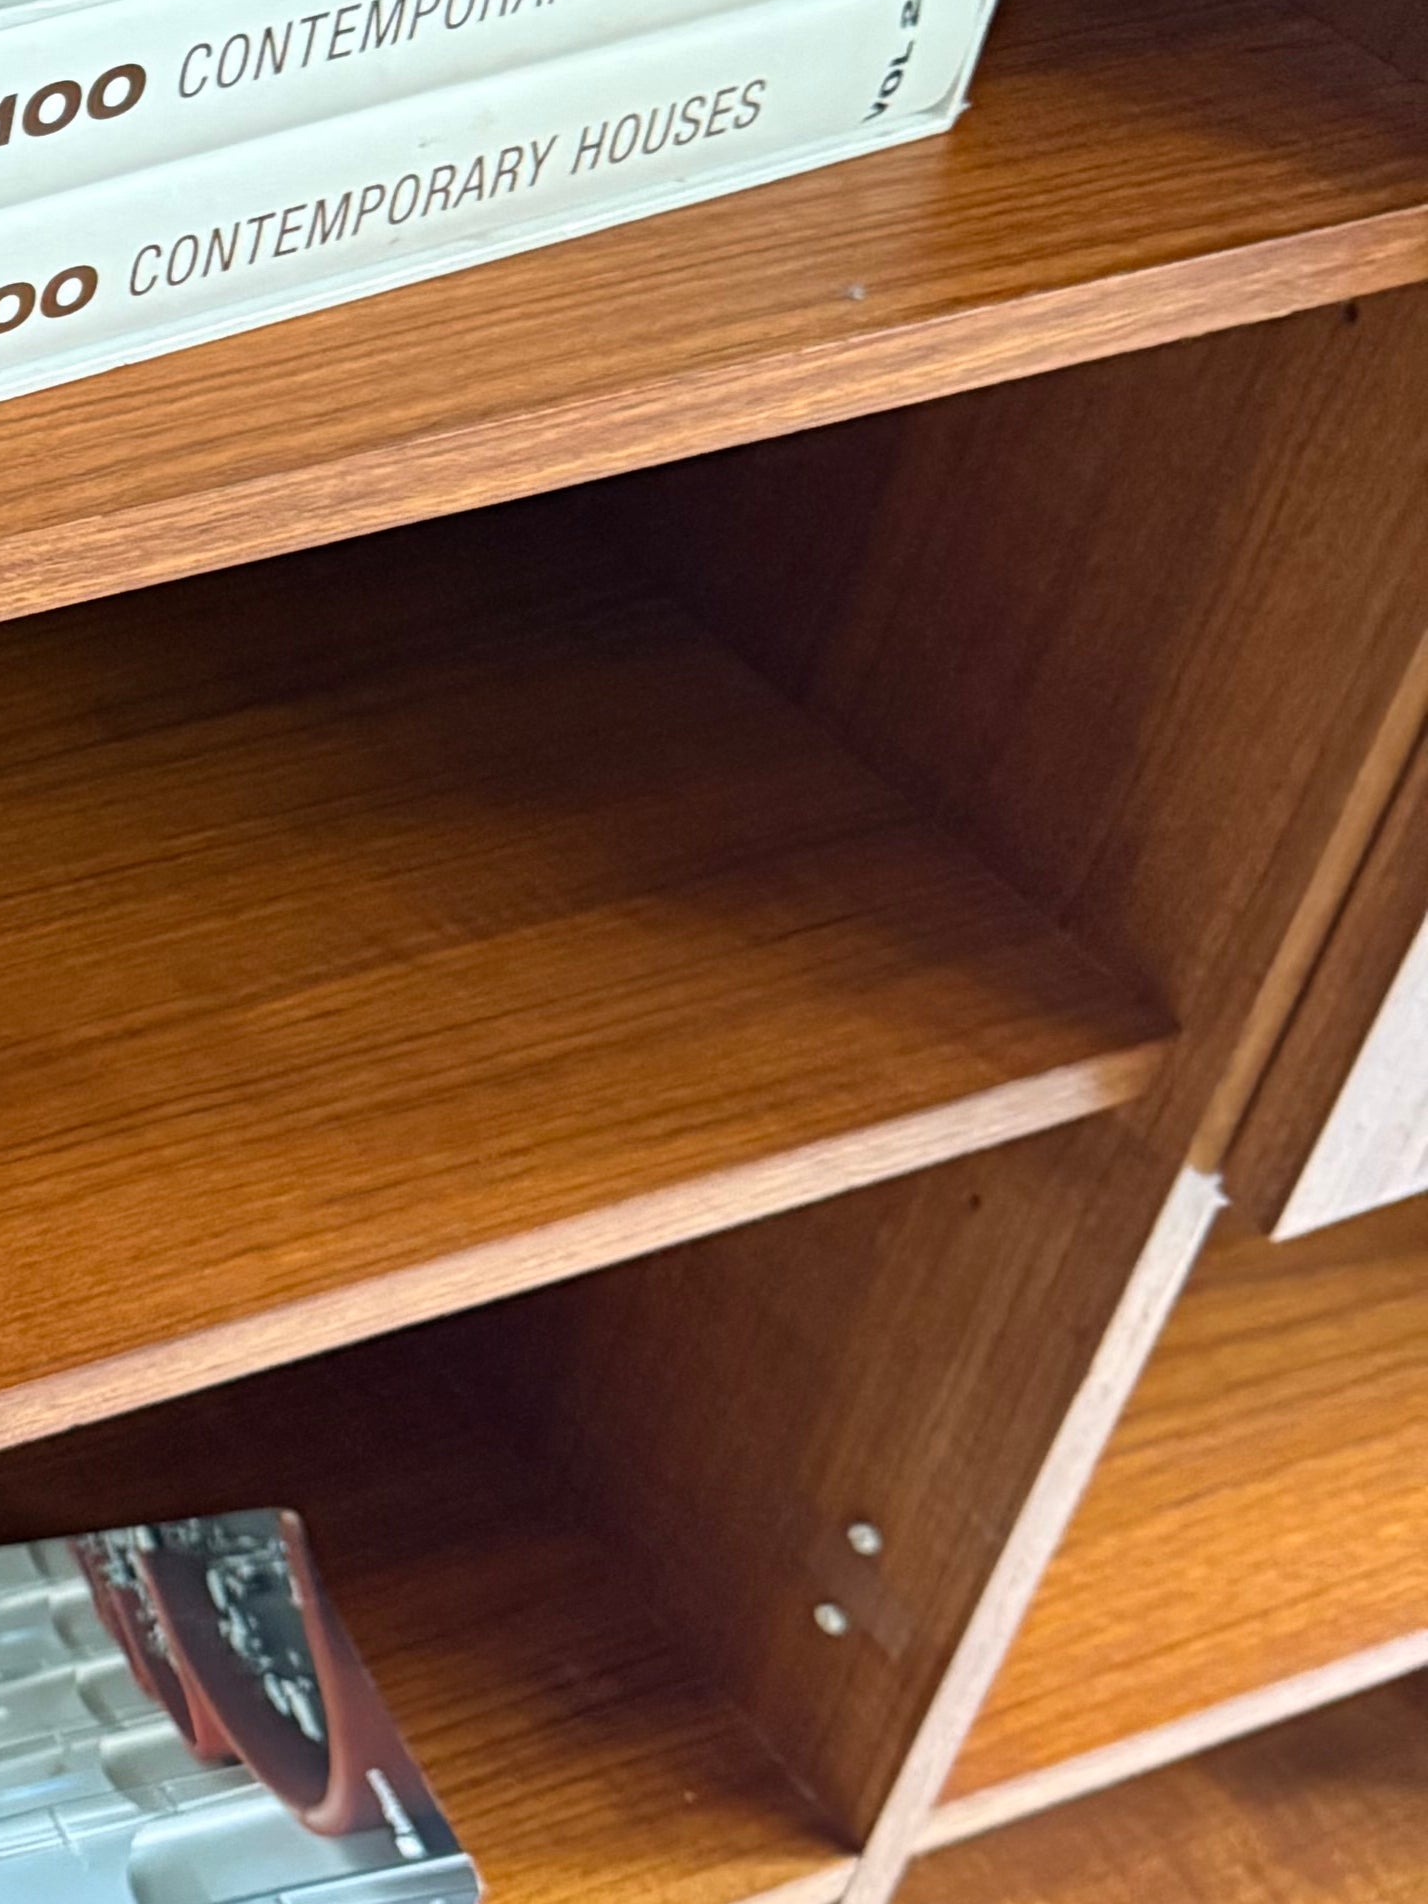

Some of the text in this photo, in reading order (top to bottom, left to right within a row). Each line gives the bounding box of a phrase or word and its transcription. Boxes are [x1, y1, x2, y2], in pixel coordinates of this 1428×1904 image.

[862, 41, 915, 123] VOL
[129, 134, 560, 297] CONTEMPORARY
[570, 79, 768, 176] HOUSES
